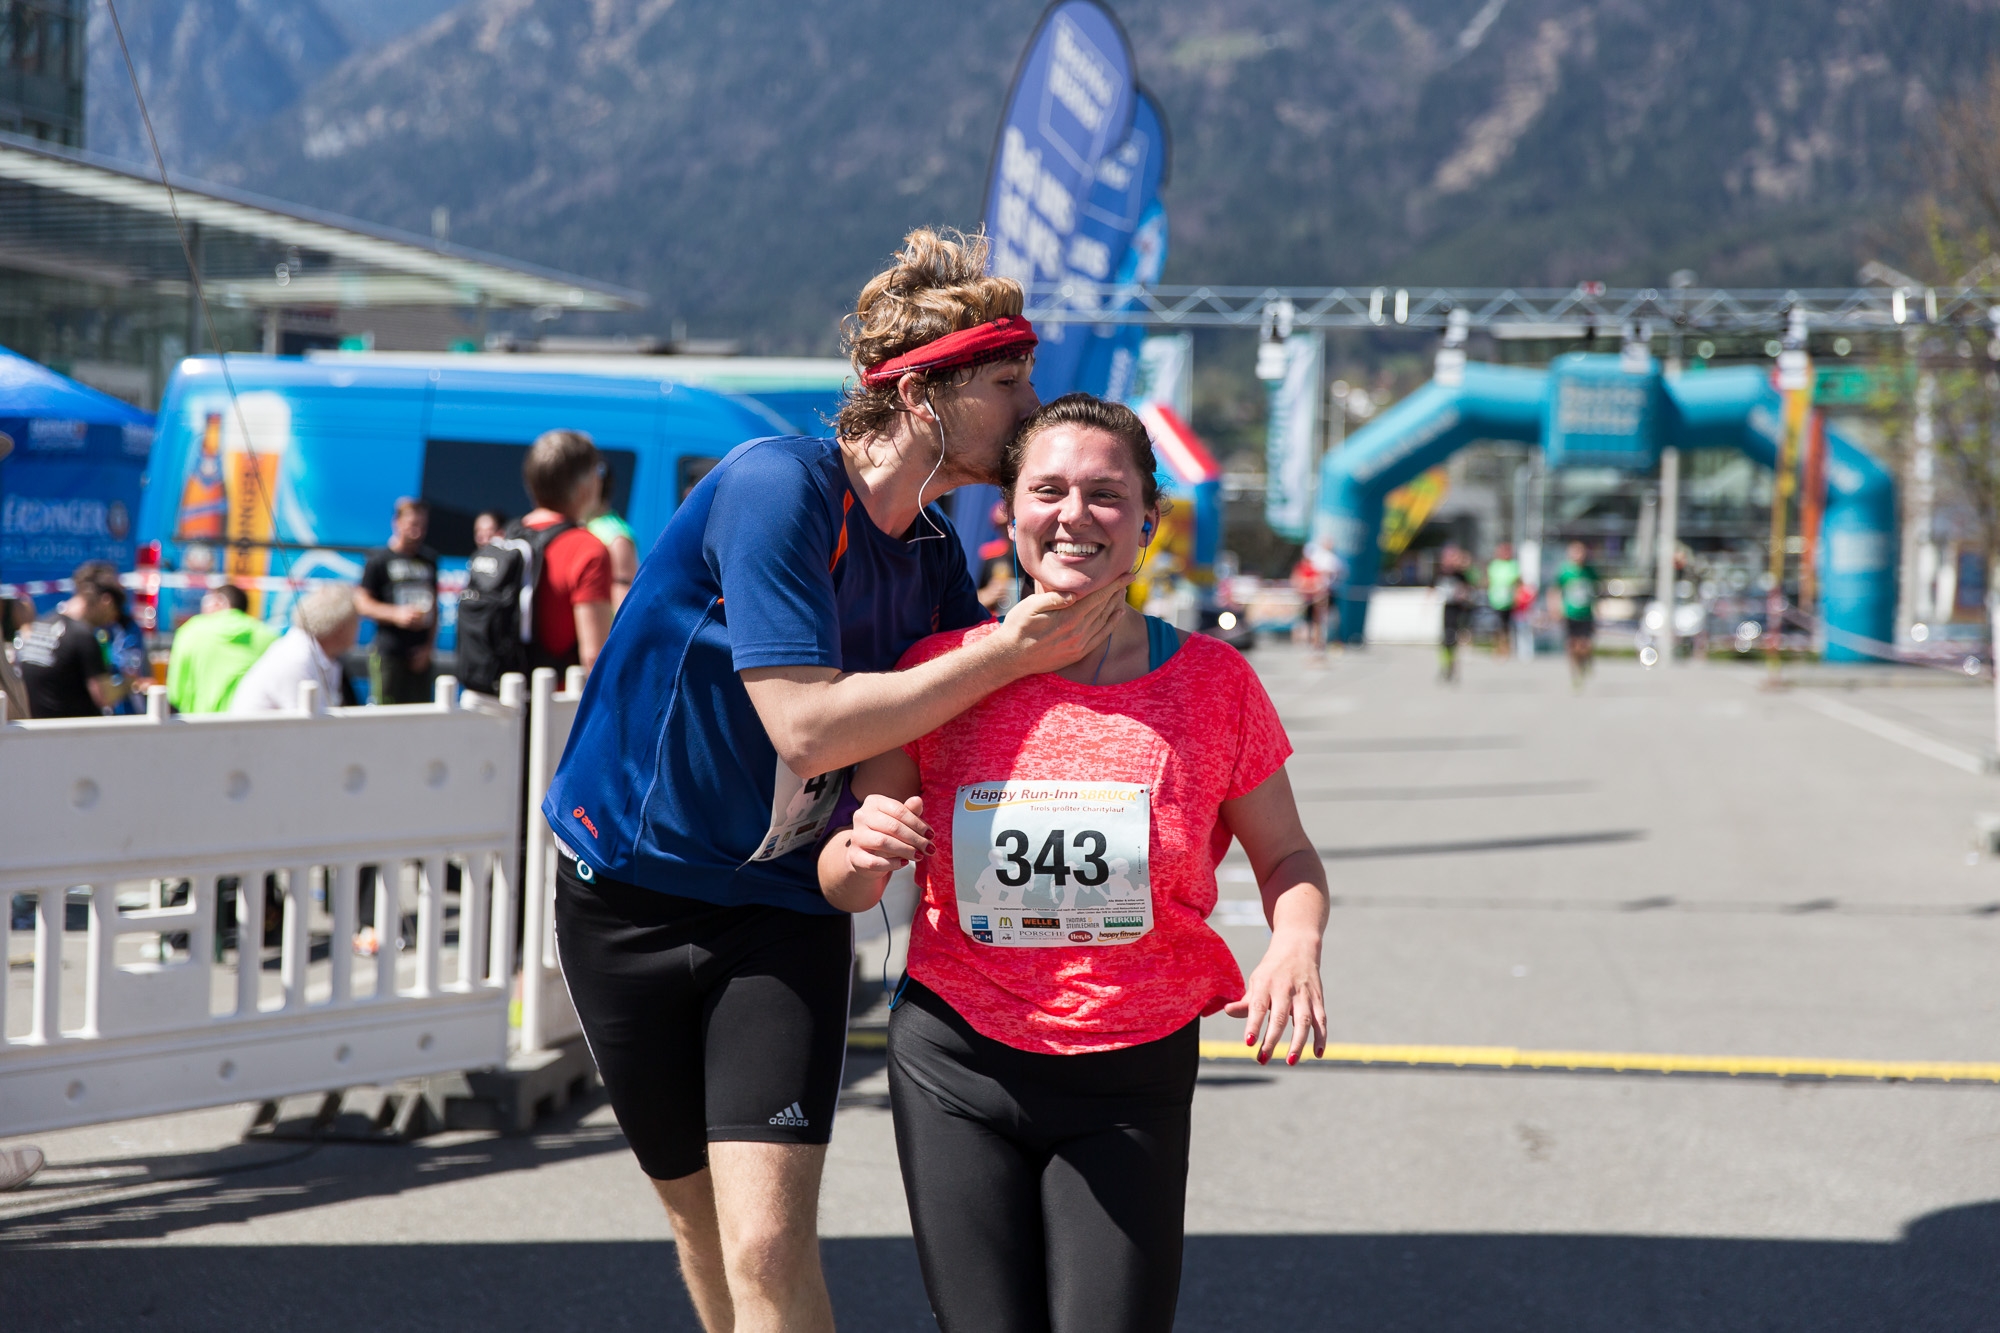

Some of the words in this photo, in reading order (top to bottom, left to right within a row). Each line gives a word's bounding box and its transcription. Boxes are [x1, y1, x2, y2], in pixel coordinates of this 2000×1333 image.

[970, 788, 1017, 802] Happy
[995, 829, 1110, 887] 343
[768, 1116, 809, 1127] adidas
